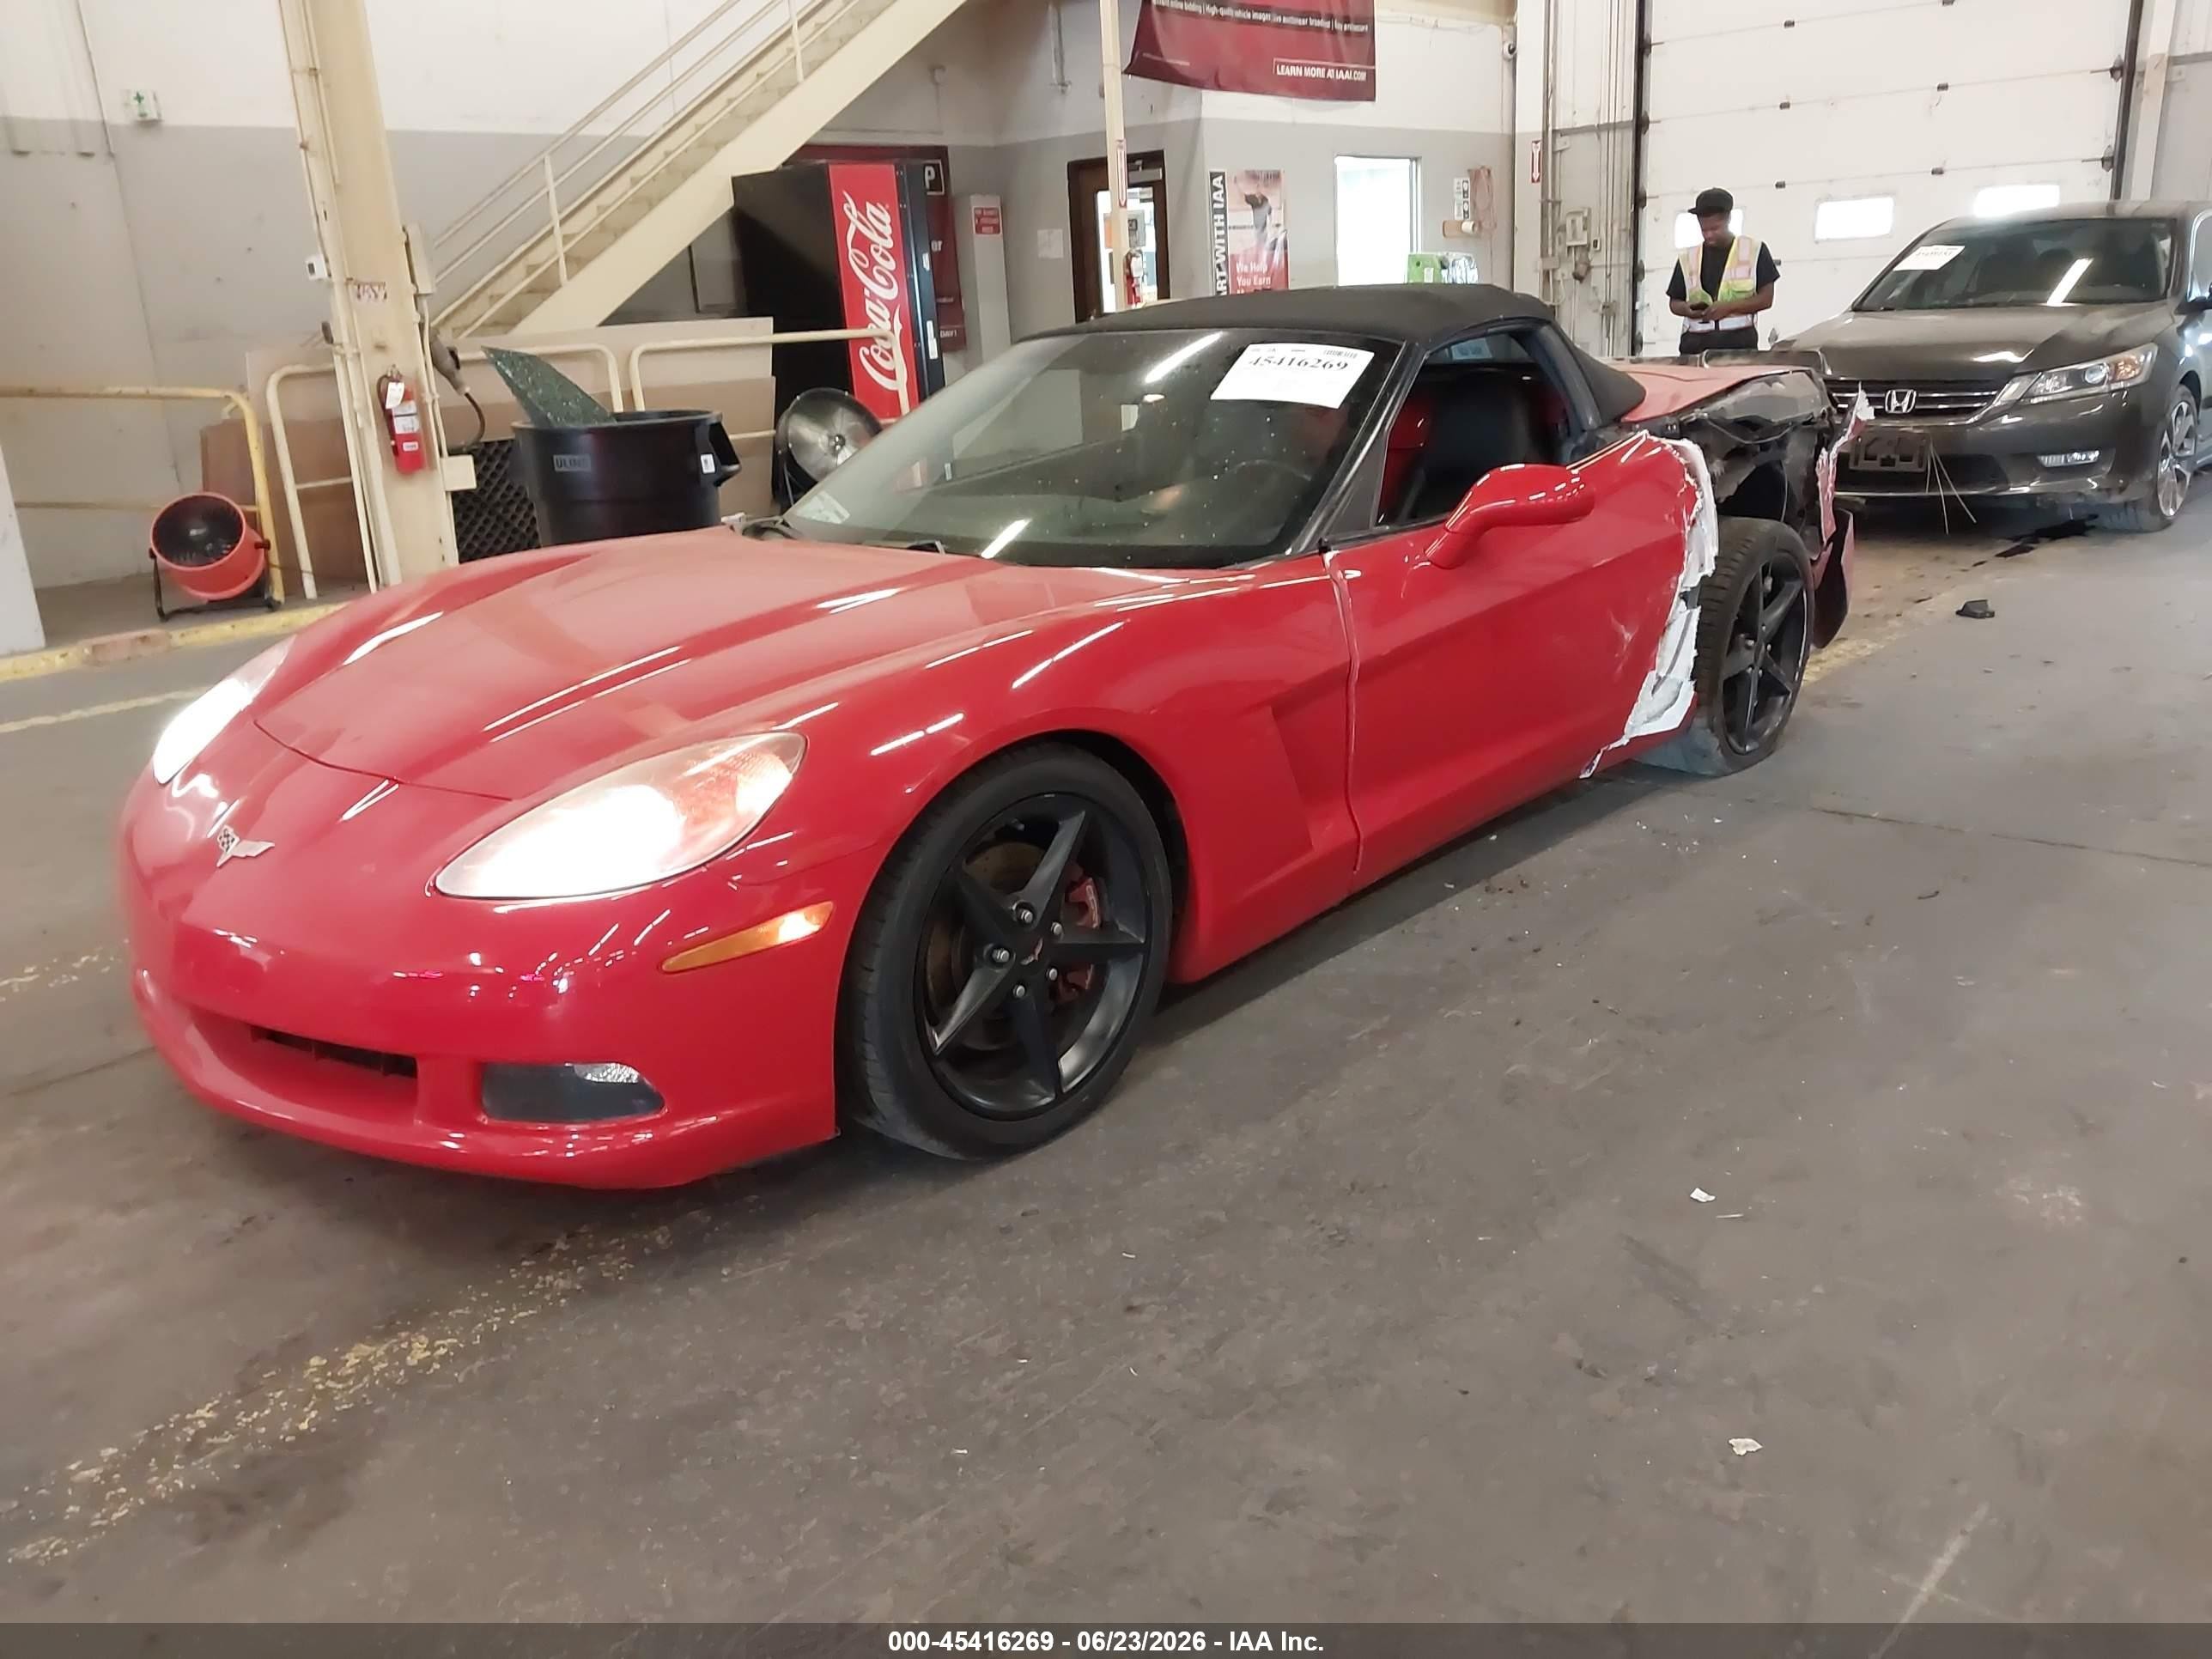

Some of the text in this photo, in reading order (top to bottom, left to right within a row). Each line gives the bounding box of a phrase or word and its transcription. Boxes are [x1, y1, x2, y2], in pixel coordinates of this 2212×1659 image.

[1276, 64, 1367, 82] LEARN MORE AT IAAI.COM
[1212, 175, 1225, 209] IAA
[1214, 214, 1226, 262] WITH
[1237, 274, 1271, 289] You Earn
[1249, 356, 1348, 371] 45416269
